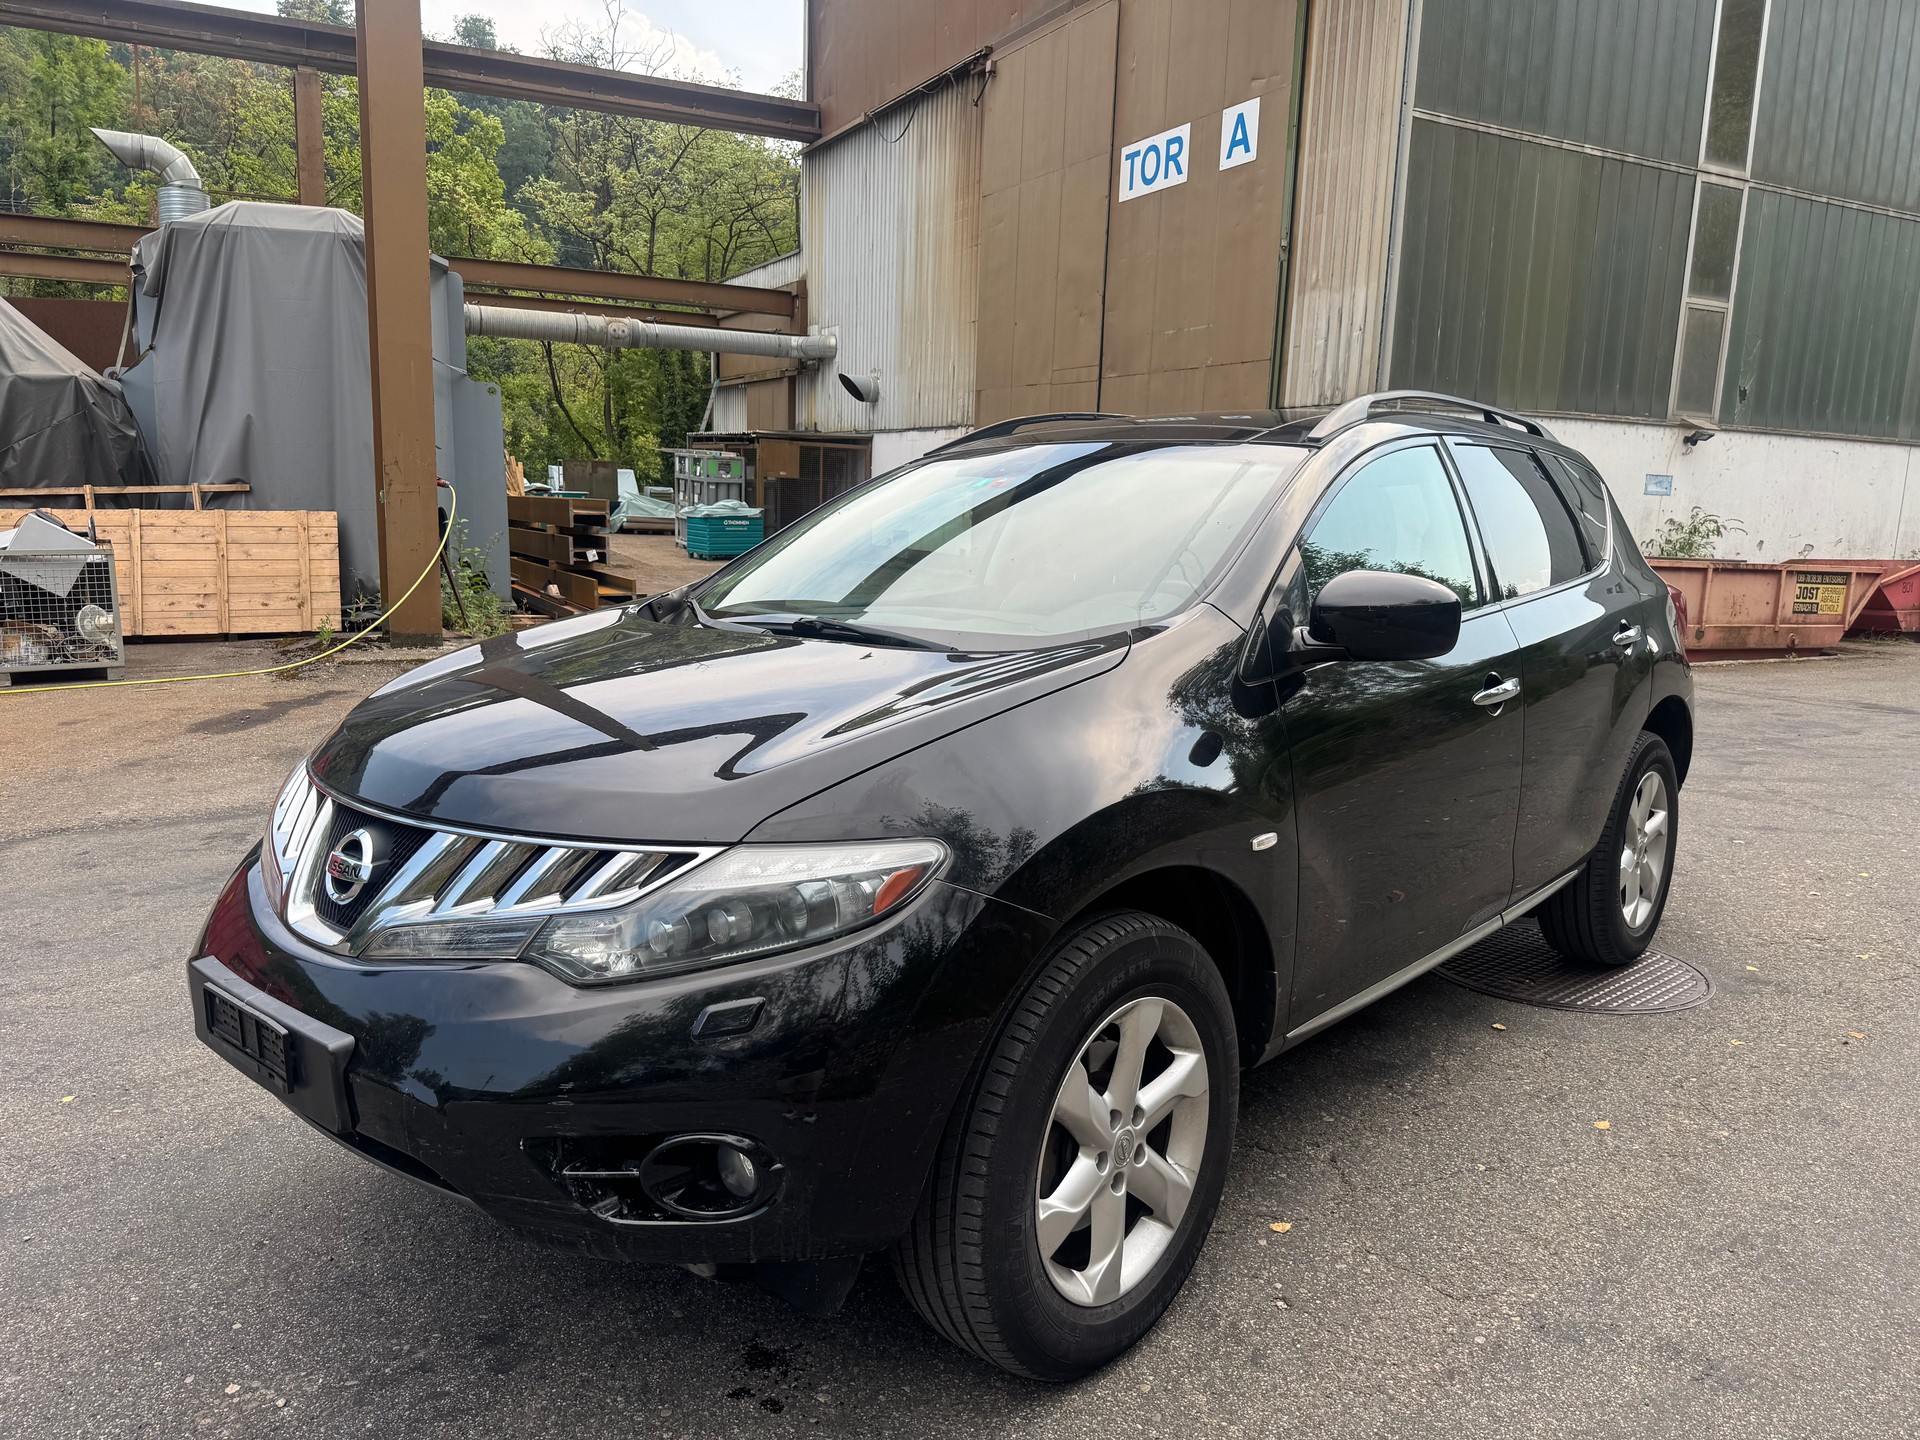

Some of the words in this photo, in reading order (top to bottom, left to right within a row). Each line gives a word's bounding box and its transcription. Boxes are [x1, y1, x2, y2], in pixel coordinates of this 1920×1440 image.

[1125, 136, 1183, 191] TOR
[1226, 112, 1251, 160] A
[1795, 586, 1820, 600] JOST
[1821, 587, 1845, 595] SPERRGUT
[1793, 603, 1812, 612] REINACH
[1819, 604, 1839, 612] ALTHOLZ
[331, 861, 361, 878] SSAN
